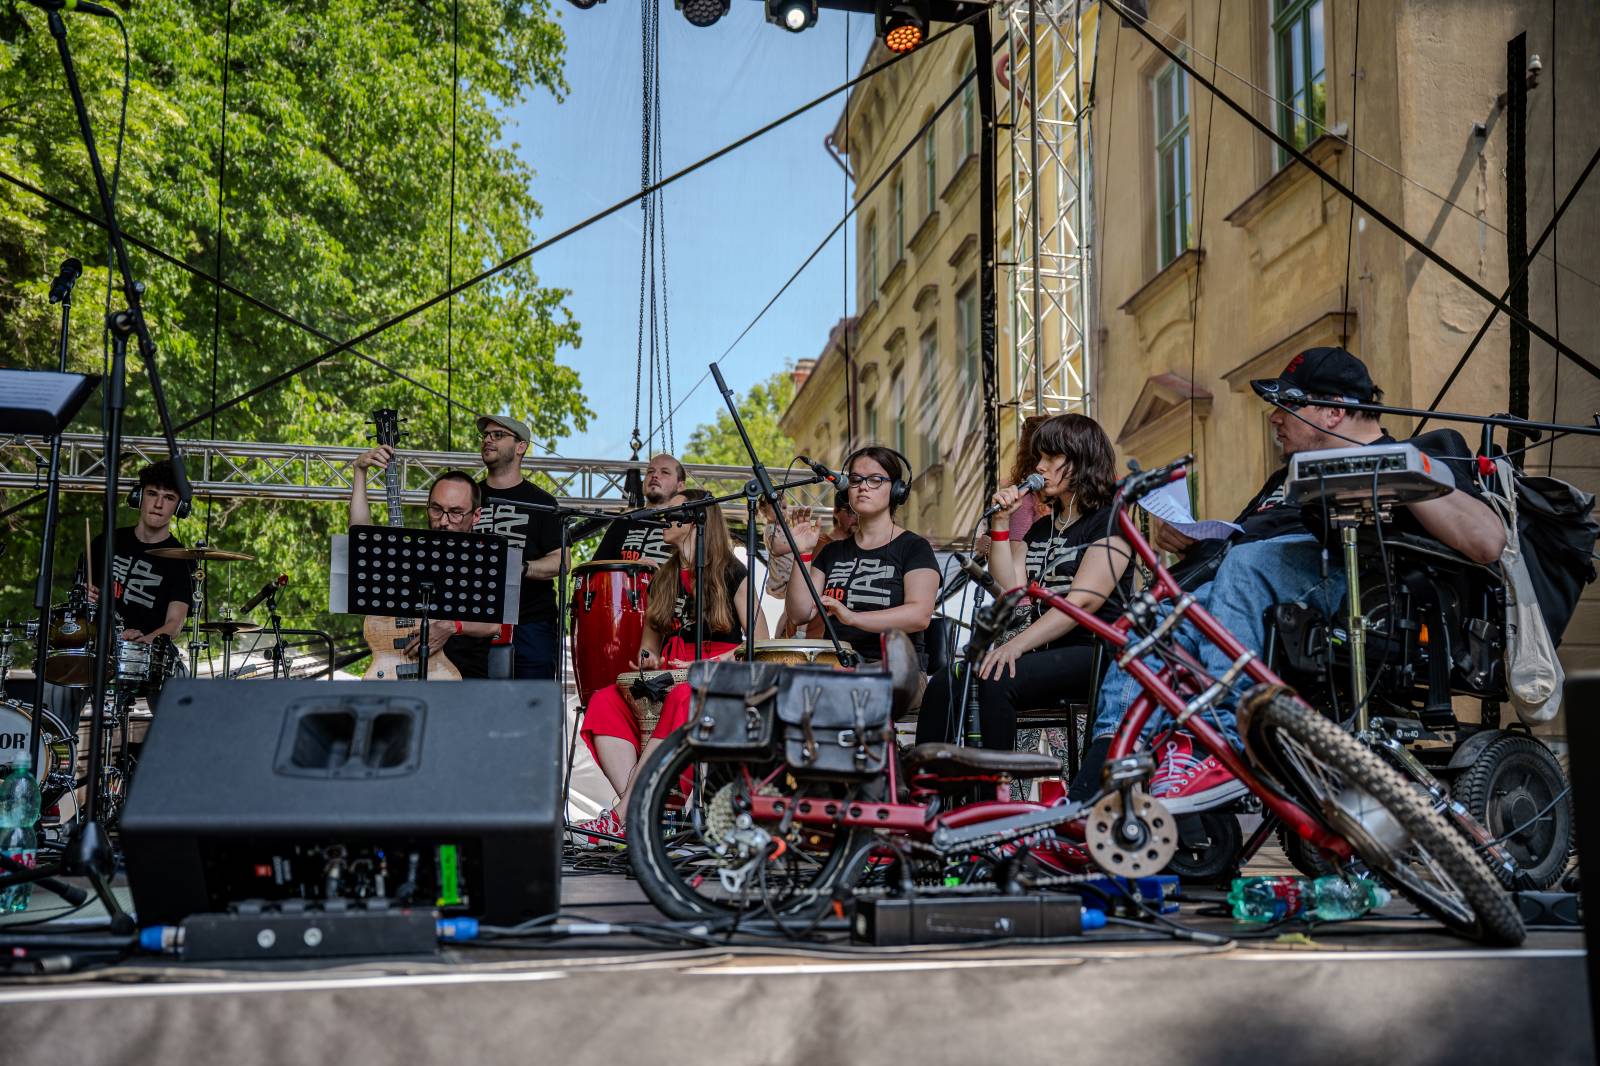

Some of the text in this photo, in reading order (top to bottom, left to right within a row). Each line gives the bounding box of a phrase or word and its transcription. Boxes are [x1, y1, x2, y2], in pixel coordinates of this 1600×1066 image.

[622, 527, 650, 550] THE
[123, 559, 163, 609] TAP
[826, 557, 858, 588] THE
[847, 558, 896, 609] TAP
